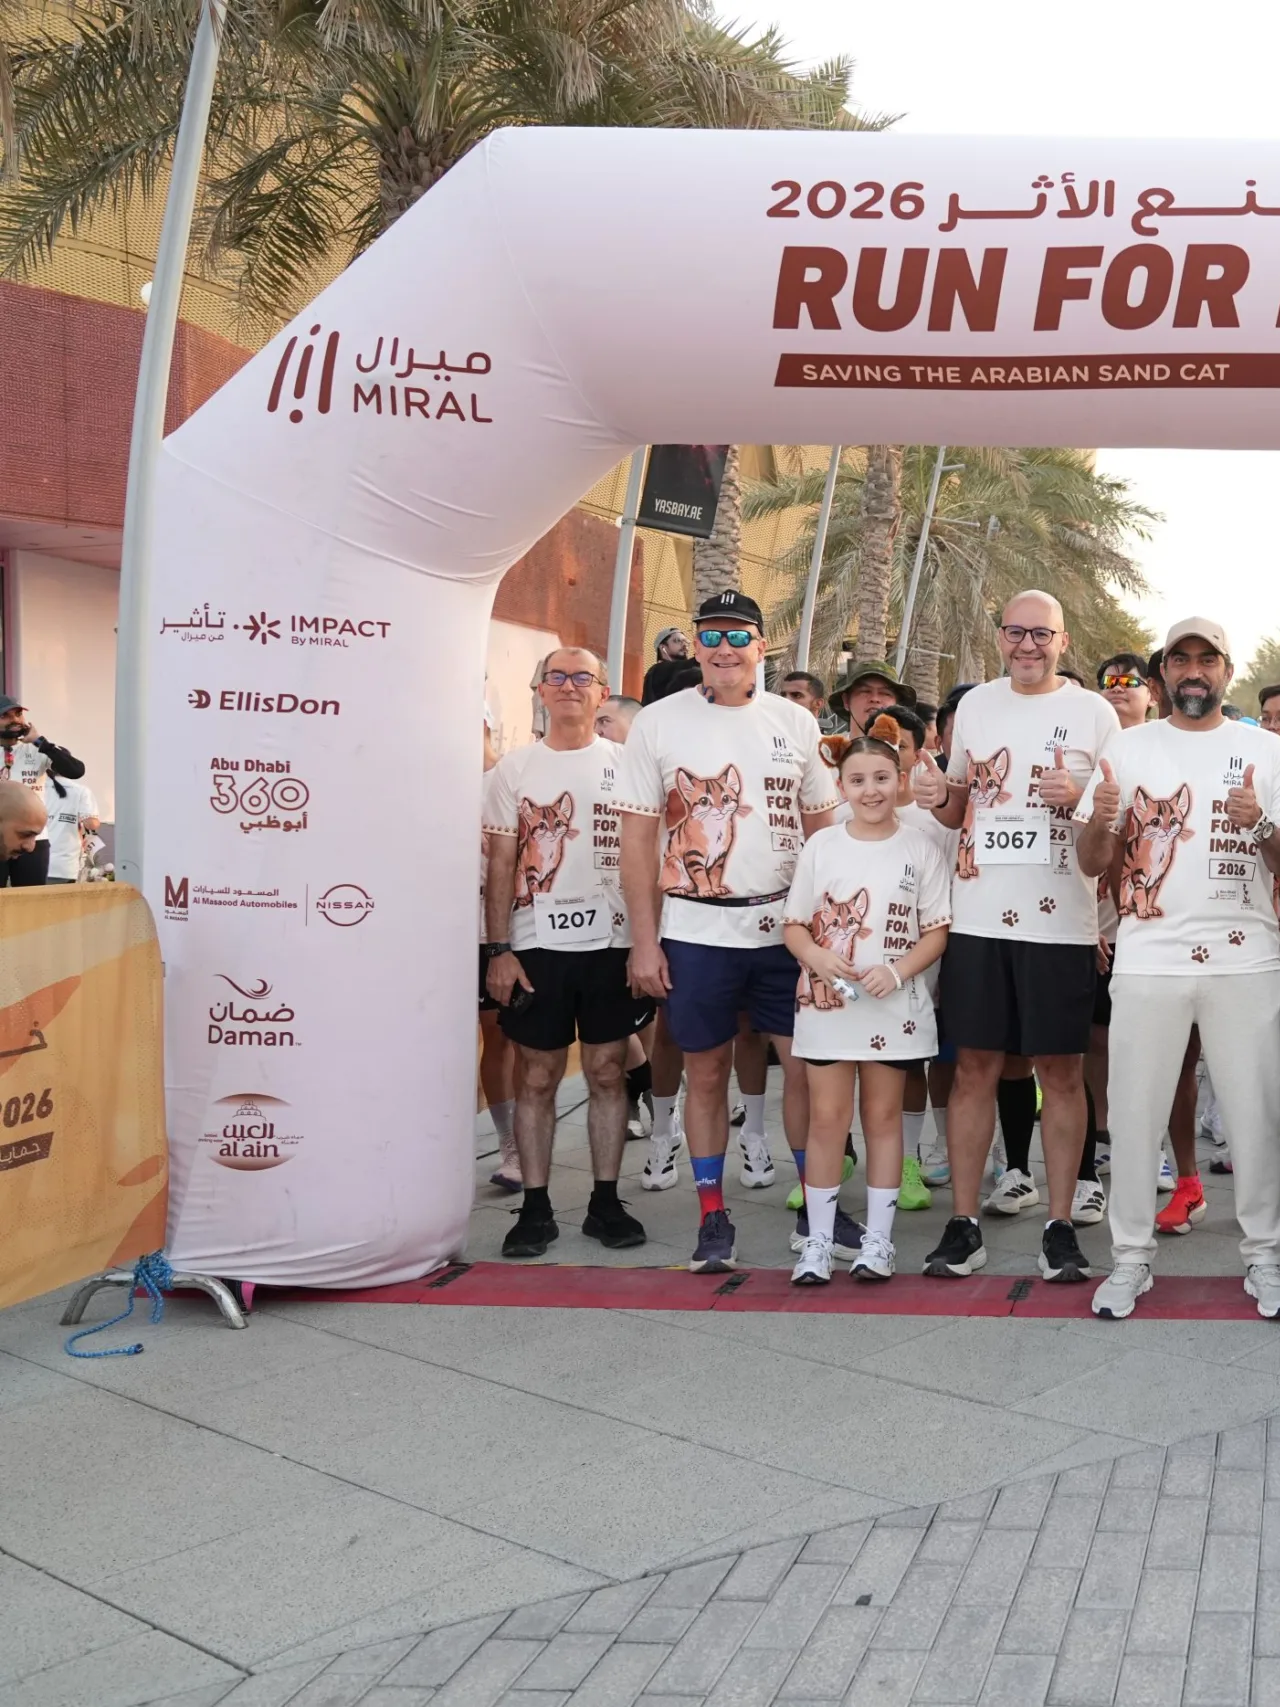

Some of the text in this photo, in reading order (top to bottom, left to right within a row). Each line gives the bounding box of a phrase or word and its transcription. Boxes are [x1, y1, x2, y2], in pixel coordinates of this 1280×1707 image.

[766, 180, 925, 219] 2026
[938, 172, 1115, 232] الأثر
[773, 245, 1008, 332] RUN
[1033, 243, 1250, 331] FOR
[356, 336, 492, 382] ميرال
[802, 363, 1230, 383] SAVING THE ARABIAN SAND CAT
[353, 383, 493, 423] MIRAL
[654, 498, 704, 520] YASBAY.AE
[160, 602, 226, 635] تأثير
[291, 615, 392, 638] IMPACT
[291, 636, 349, 648] By MIRAL
[219, 690, 341, 715] EllisDon
[210, 757, 291, 774] Abu Dhabi
[210, 774, 310, 815] 360
[593, 819, 617, 832] FOR
[1050, 828, 1067, 841] 26
[593, 835, 620, 848] IMPA
[984, 831, 1038, 849] 3067
[1209, 838, 1258, 856] IMPAC
[1217, 863, 1246, 876] 2026
[193, 896, 298, 909] Al Masaood Automobiles
[316, 901, 375, 909] NISSAN
[548, 909, 596, 930] 1207
[209, 1002, 295, 1023] ضمان
[207, 1024, 294, 1047] Daman
[0, 1088, 53, 1128] 026
[223, 1122, 275, 1141] العين
[0, 1143, 41, 1164] حماي
[219, 1141, 280, 1158] al ain
